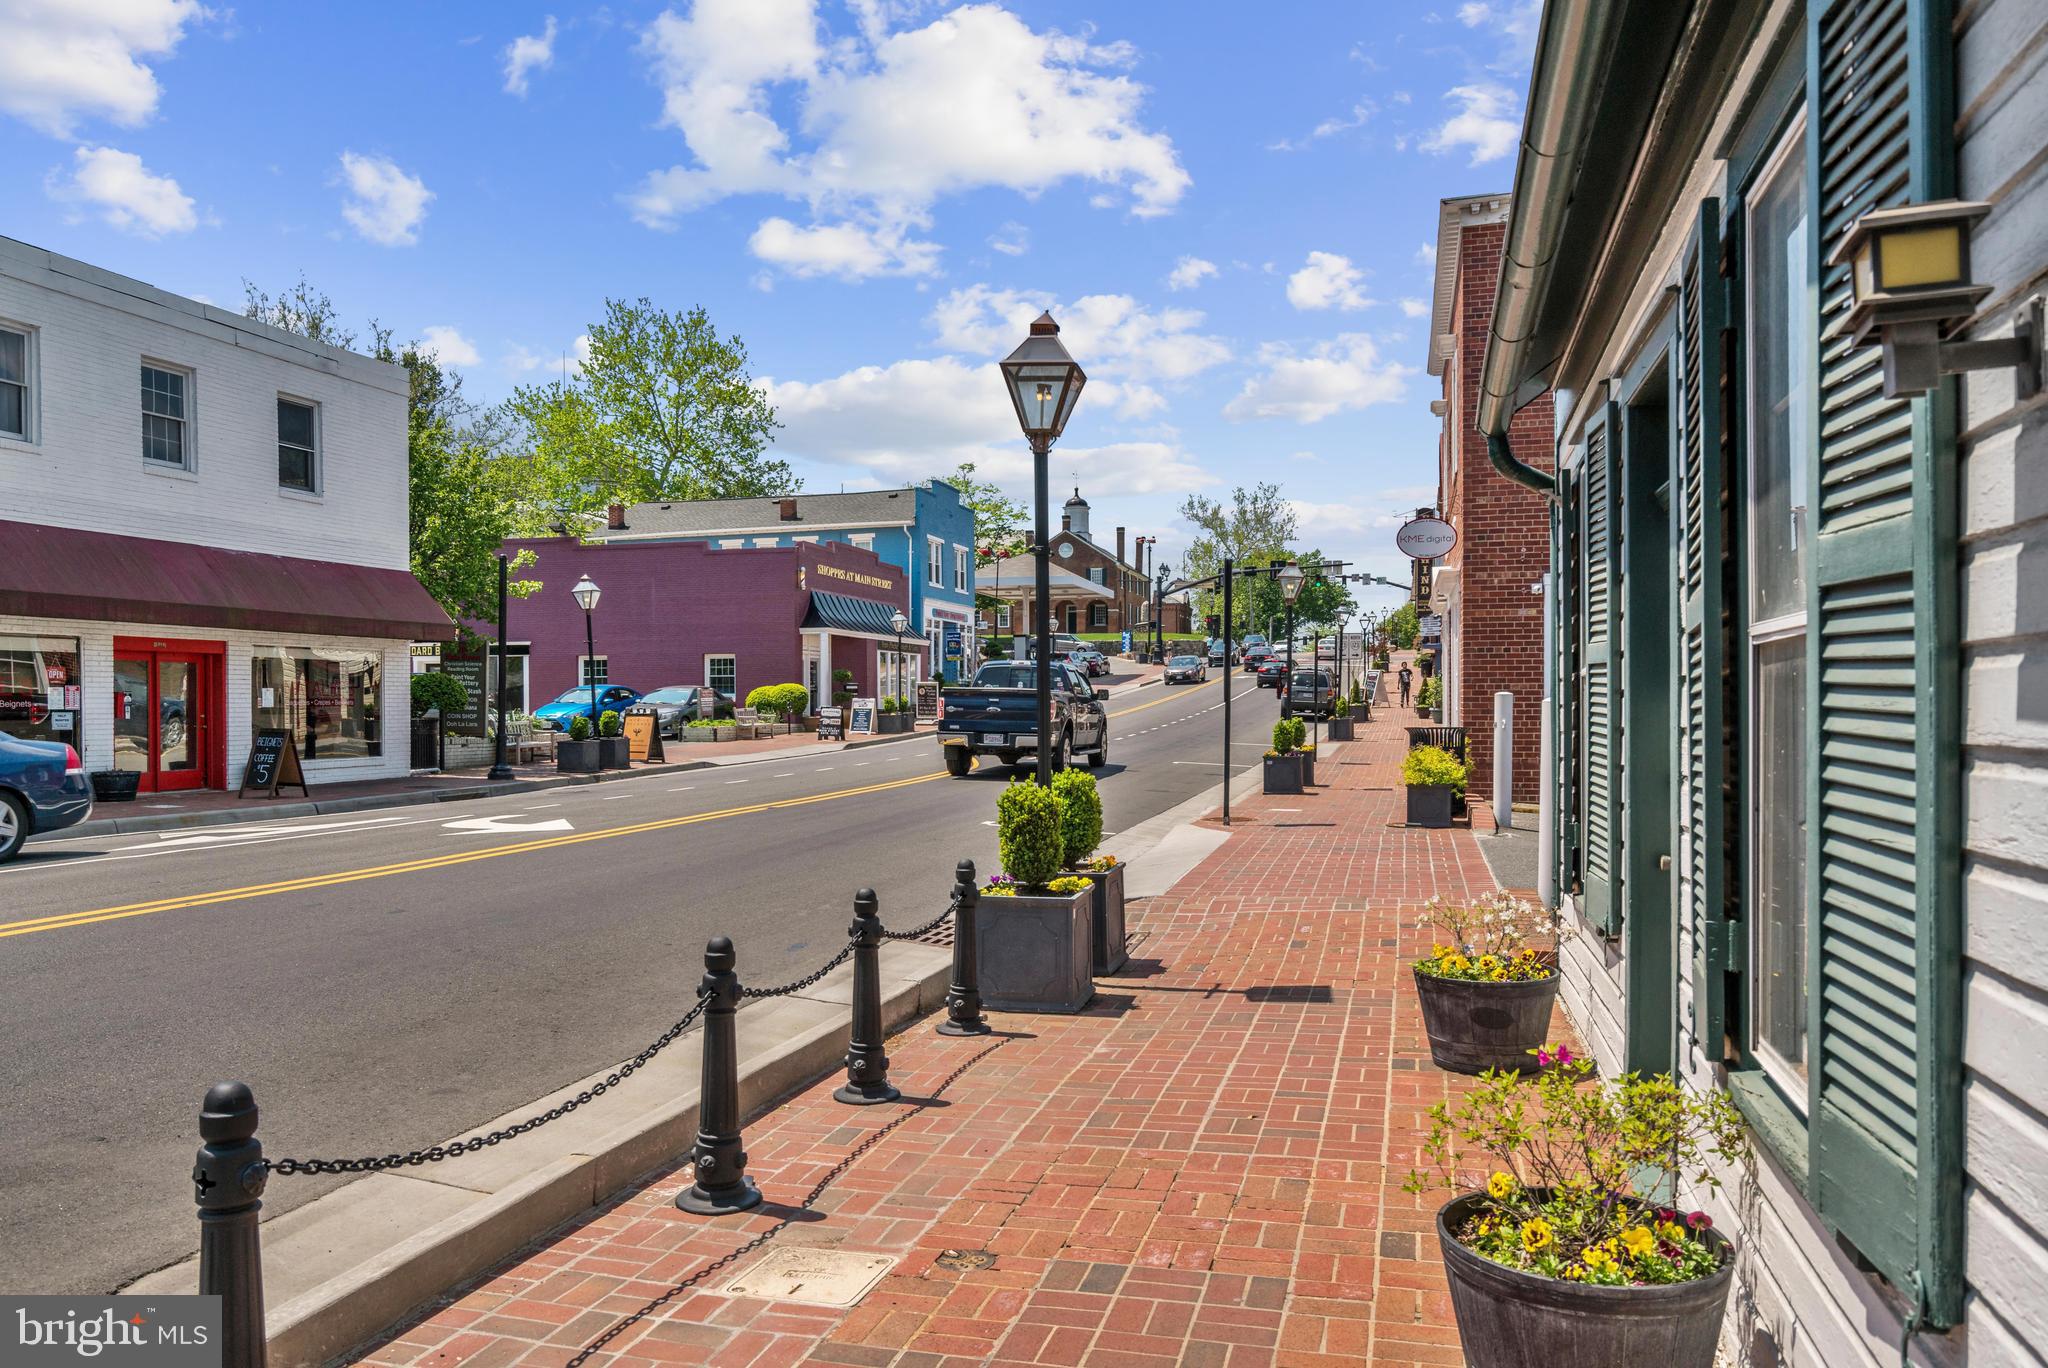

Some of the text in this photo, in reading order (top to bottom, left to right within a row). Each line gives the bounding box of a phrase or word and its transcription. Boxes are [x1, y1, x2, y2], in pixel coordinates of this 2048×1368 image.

[1399, 535, 1454, 544] KME digital
[817, 564, 893, 590] SHOPPES AT MAIN STREET
[48, 670, 64, 679] OPEN
[0, 700, 32, 709] Beignets
[257, 736, 284, 747] BEIGNETS
[254, 753, 276, 763] COFFEE
